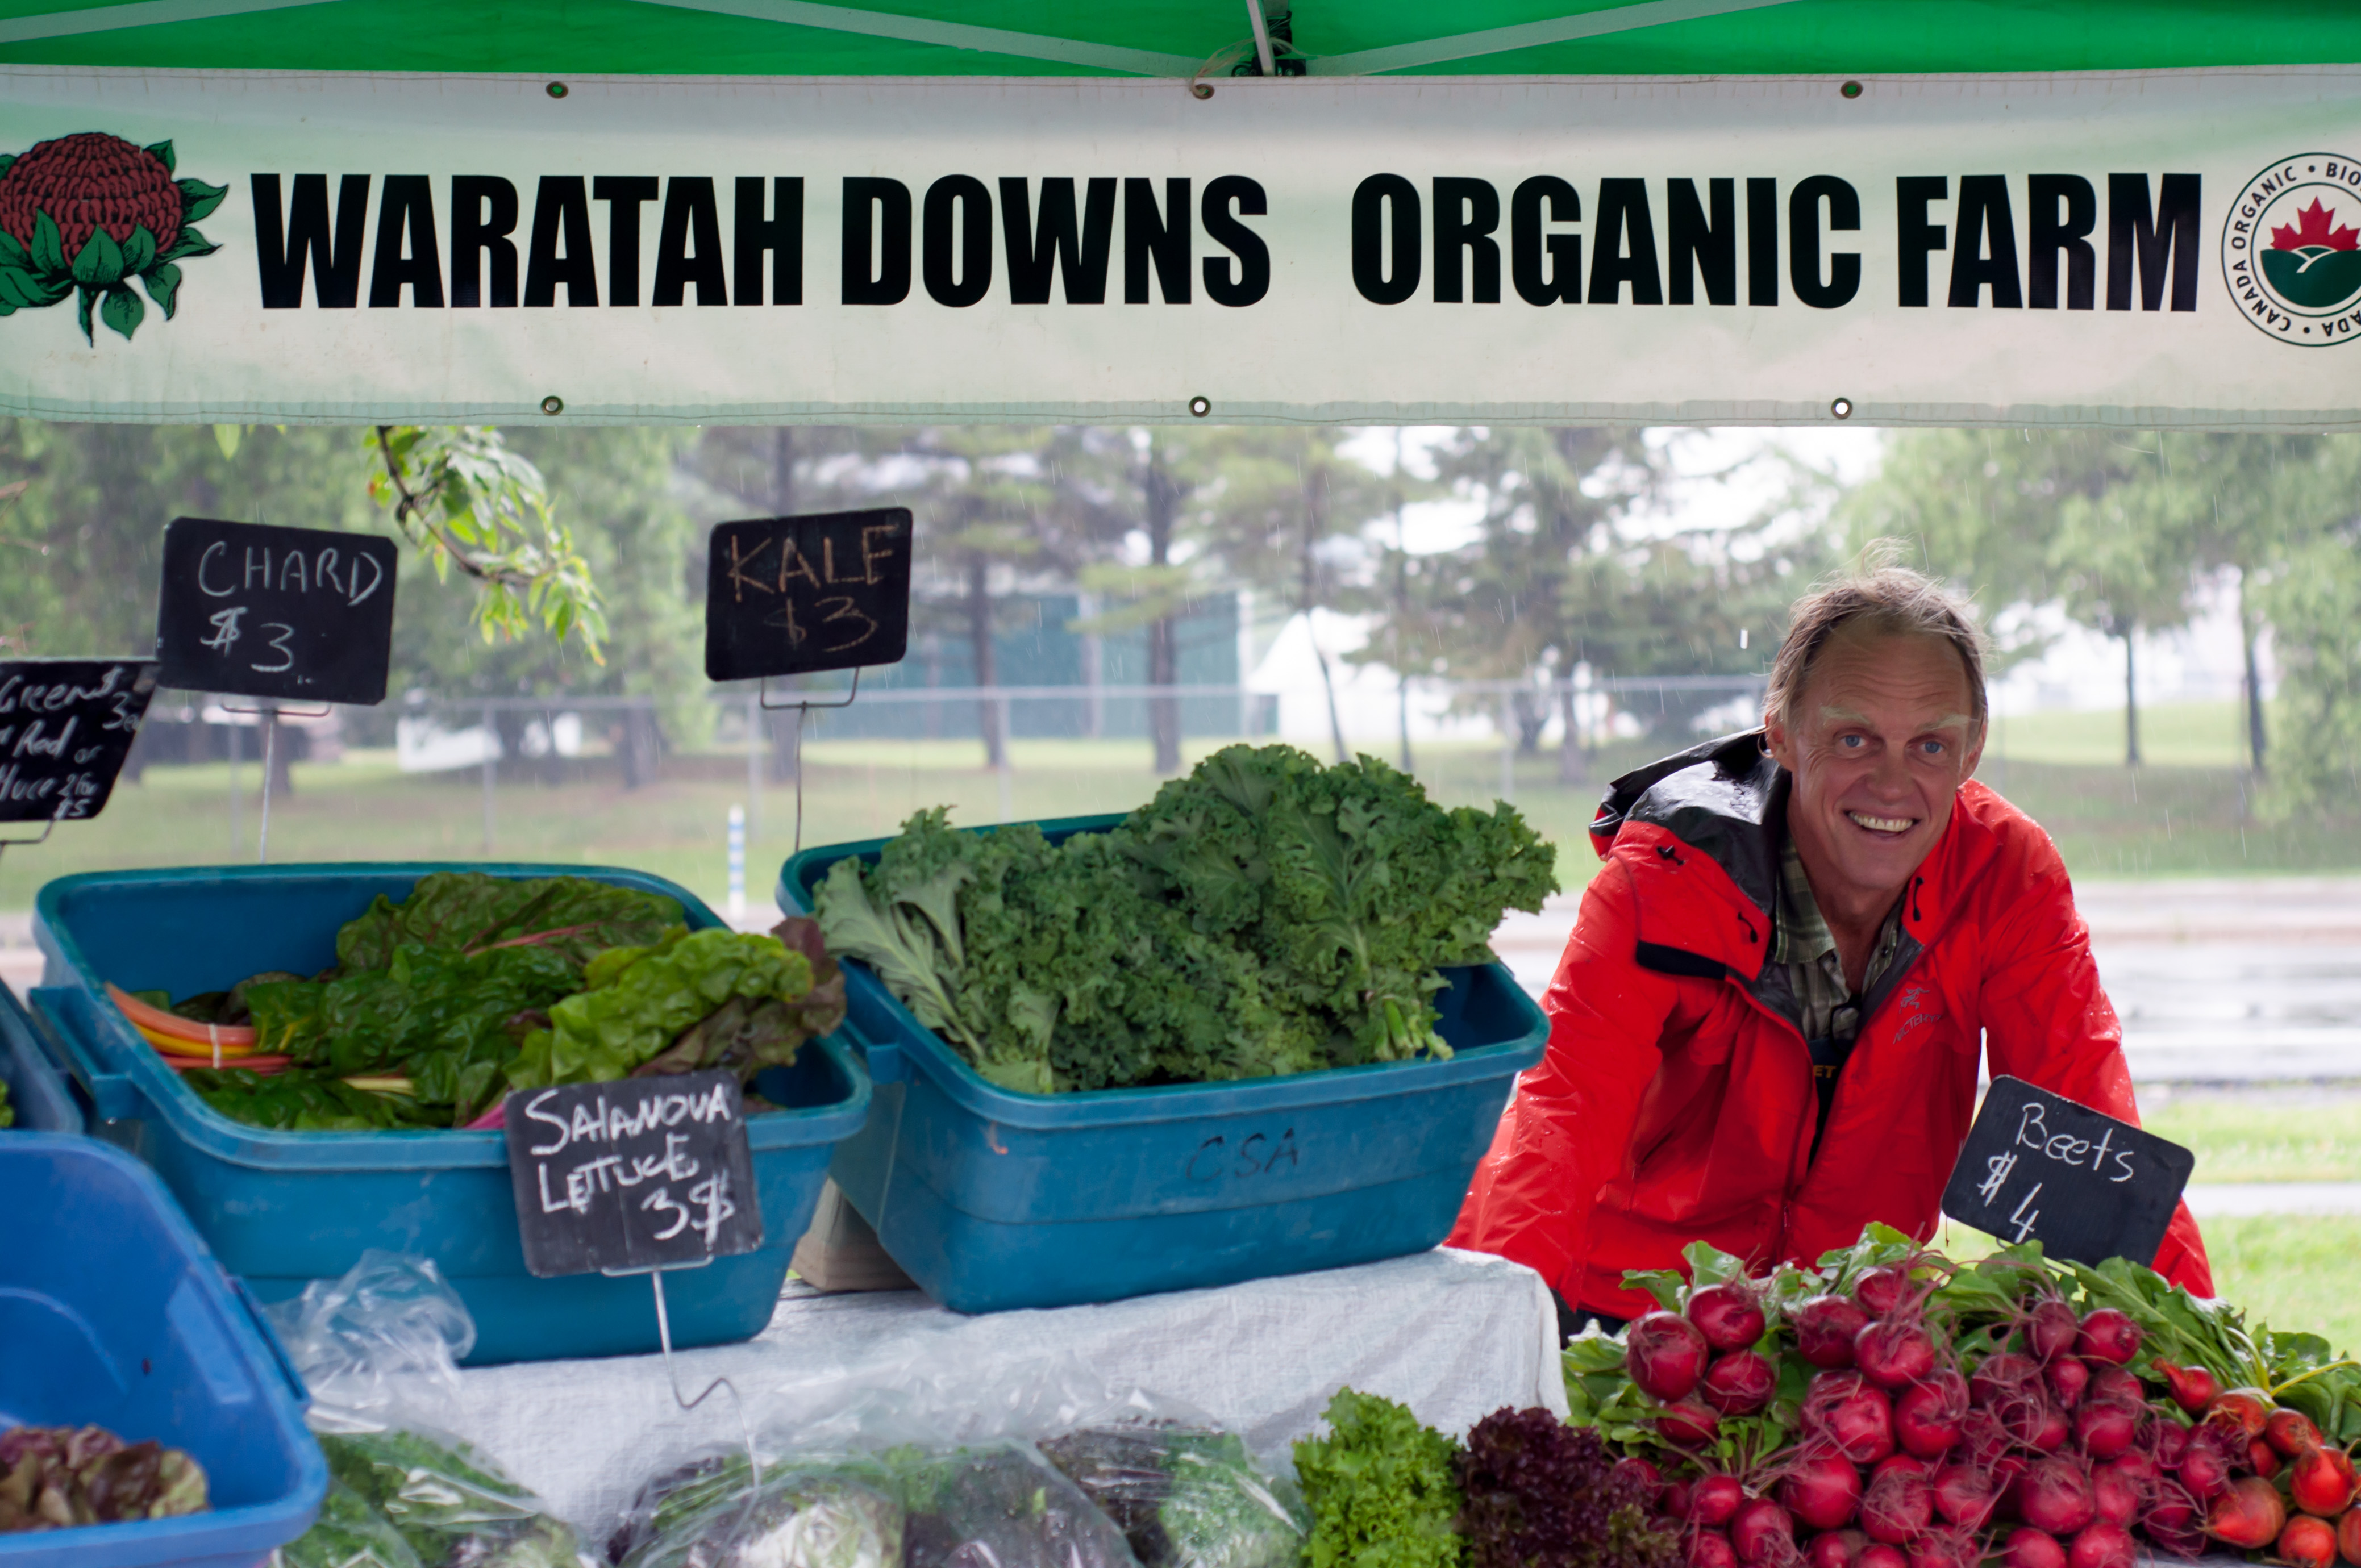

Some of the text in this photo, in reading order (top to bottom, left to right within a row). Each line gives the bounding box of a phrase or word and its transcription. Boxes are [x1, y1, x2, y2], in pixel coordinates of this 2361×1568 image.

[251, 173, 2201, 311] WARATAH DOWNS ORGANIC FARM
[2231, 166, 2297, 332] CANADA ORGANIC
[199, 541, 383, 606] CHARD
[727, 523, 901, 602] KALE
[538, 1132, 699, 1215] LETTUCE
[1186, 1127, 1298, 1182] CSA
[2015, 1102, 2135, 1182] Beets
